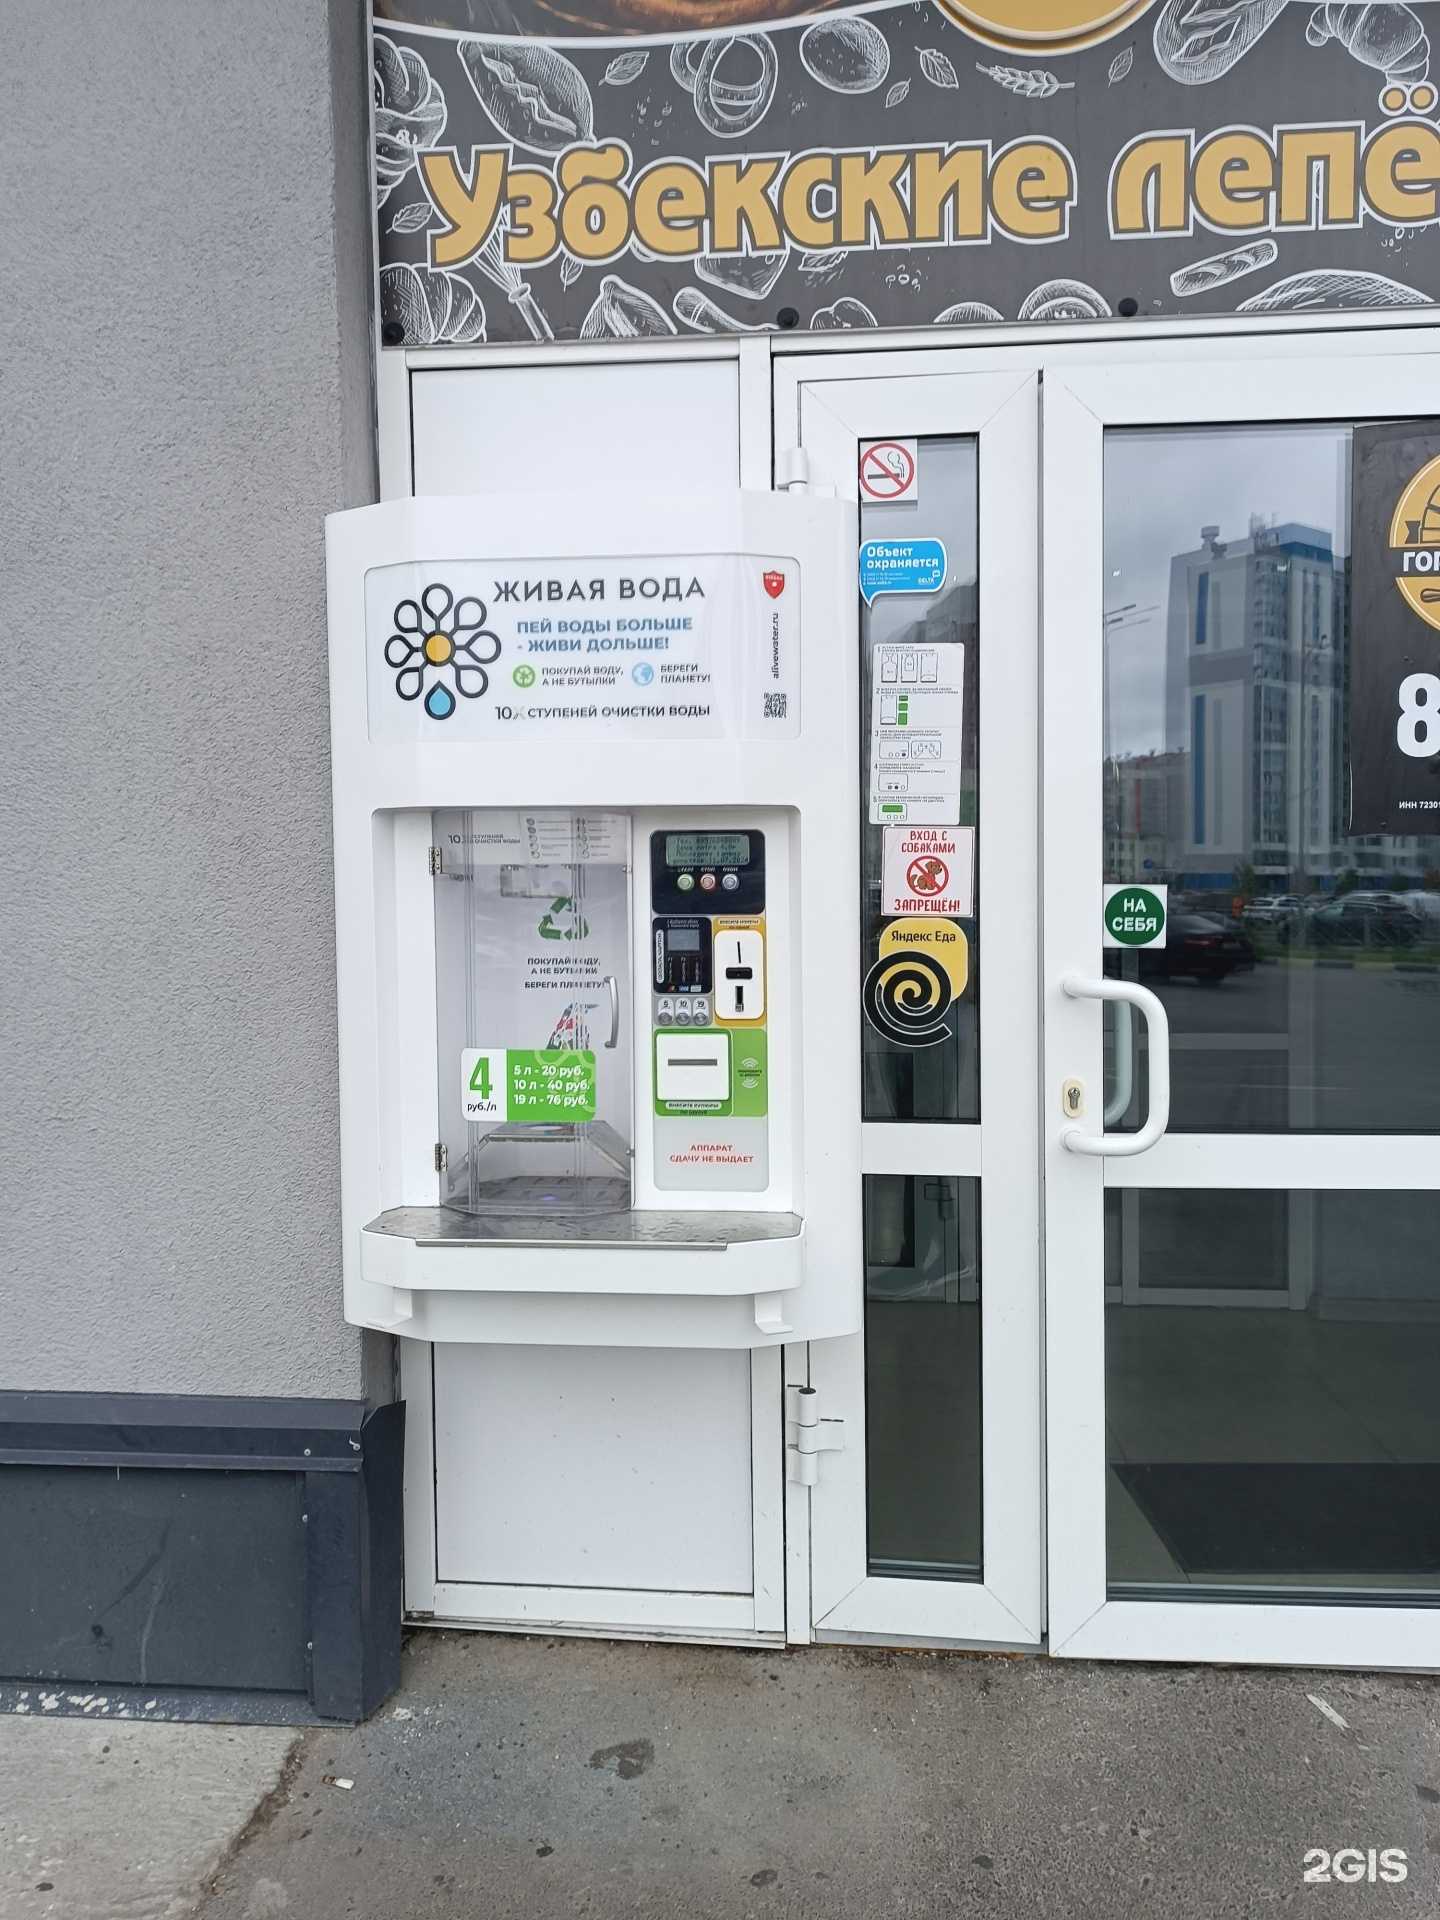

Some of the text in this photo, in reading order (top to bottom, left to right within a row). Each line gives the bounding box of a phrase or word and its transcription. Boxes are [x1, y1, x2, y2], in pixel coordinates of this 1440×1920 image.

[417, 138, 1077, 272] Узбекские
[867, 546, 913, 557] Объект
[867, 558, 939, 571] охраняется
[493, 576, 705, 602] ЖИВАЯ ВОДА
[517, 617, 692, 634] ПЕЙ ВОДЫ БОЛЬШЕ
[528, 639, 581, 651] ЖИВИ
[587, 637, 669, 652] ДОЛЬШЕ!
[542, 665, 624, 676] ПОКУПАЙ ВОДУ,
[660, 664, 698, 673] БЕРЕГИ
[542, 677, 616, 686] А НЕ БУТЫЛКИ
[660, 674, 711, 684] ПЛАНЕТУ!
[527, 705, 597, 718] СТУПЕНЕЙ
[601, 706, 665, 718] ОЧИСТКИ
[668, 705, 710, 717] ВОДЫ
[1399, 800, 1418, 809] ИНН
[910, 830, 948, 842] ВХОД С
[901, 842, 956, 854] СОБАКАМИ
[894, 898, 960, 913] ЗАПРЕЩЁН!
[1123, 897, 1147, 913] НА
[1112, 916, 1157, 932] СЕБЯ
[891, 930, 956, 942] Яндекс Еда
[527, 957, 571, 965] ПОКУПАЙ
[525, 981, 557, 989] БЕРЕГИ
[513, 1065, 521, 1076] 5
[524, 1067, 531, 1075] л
[542, 1065, 556, 1076] 20
[559, 1065, 584, 1078] руб.
[469, 1057, 493, 1100] 4
[513, 1079, 525, 1090] 10
[529, 1082, 537, 1090] л
[547, 1079, 563, 1090] 40
[566, 1079, 590, 1092] руб.
[467, 1101, 497, 1112] руб./л
[513, 1094, 525, 1104] 19
[529, 1096, 537, 1104] л
[547, 1094, 561, 1105] 76
[564, 1094, 588, 1107] руб.
[690, 1144, 733, 1152] АППАРАТ
[669, 1155, 754, 1164] СДАЧУ НЕ ВЫДАЕТ
